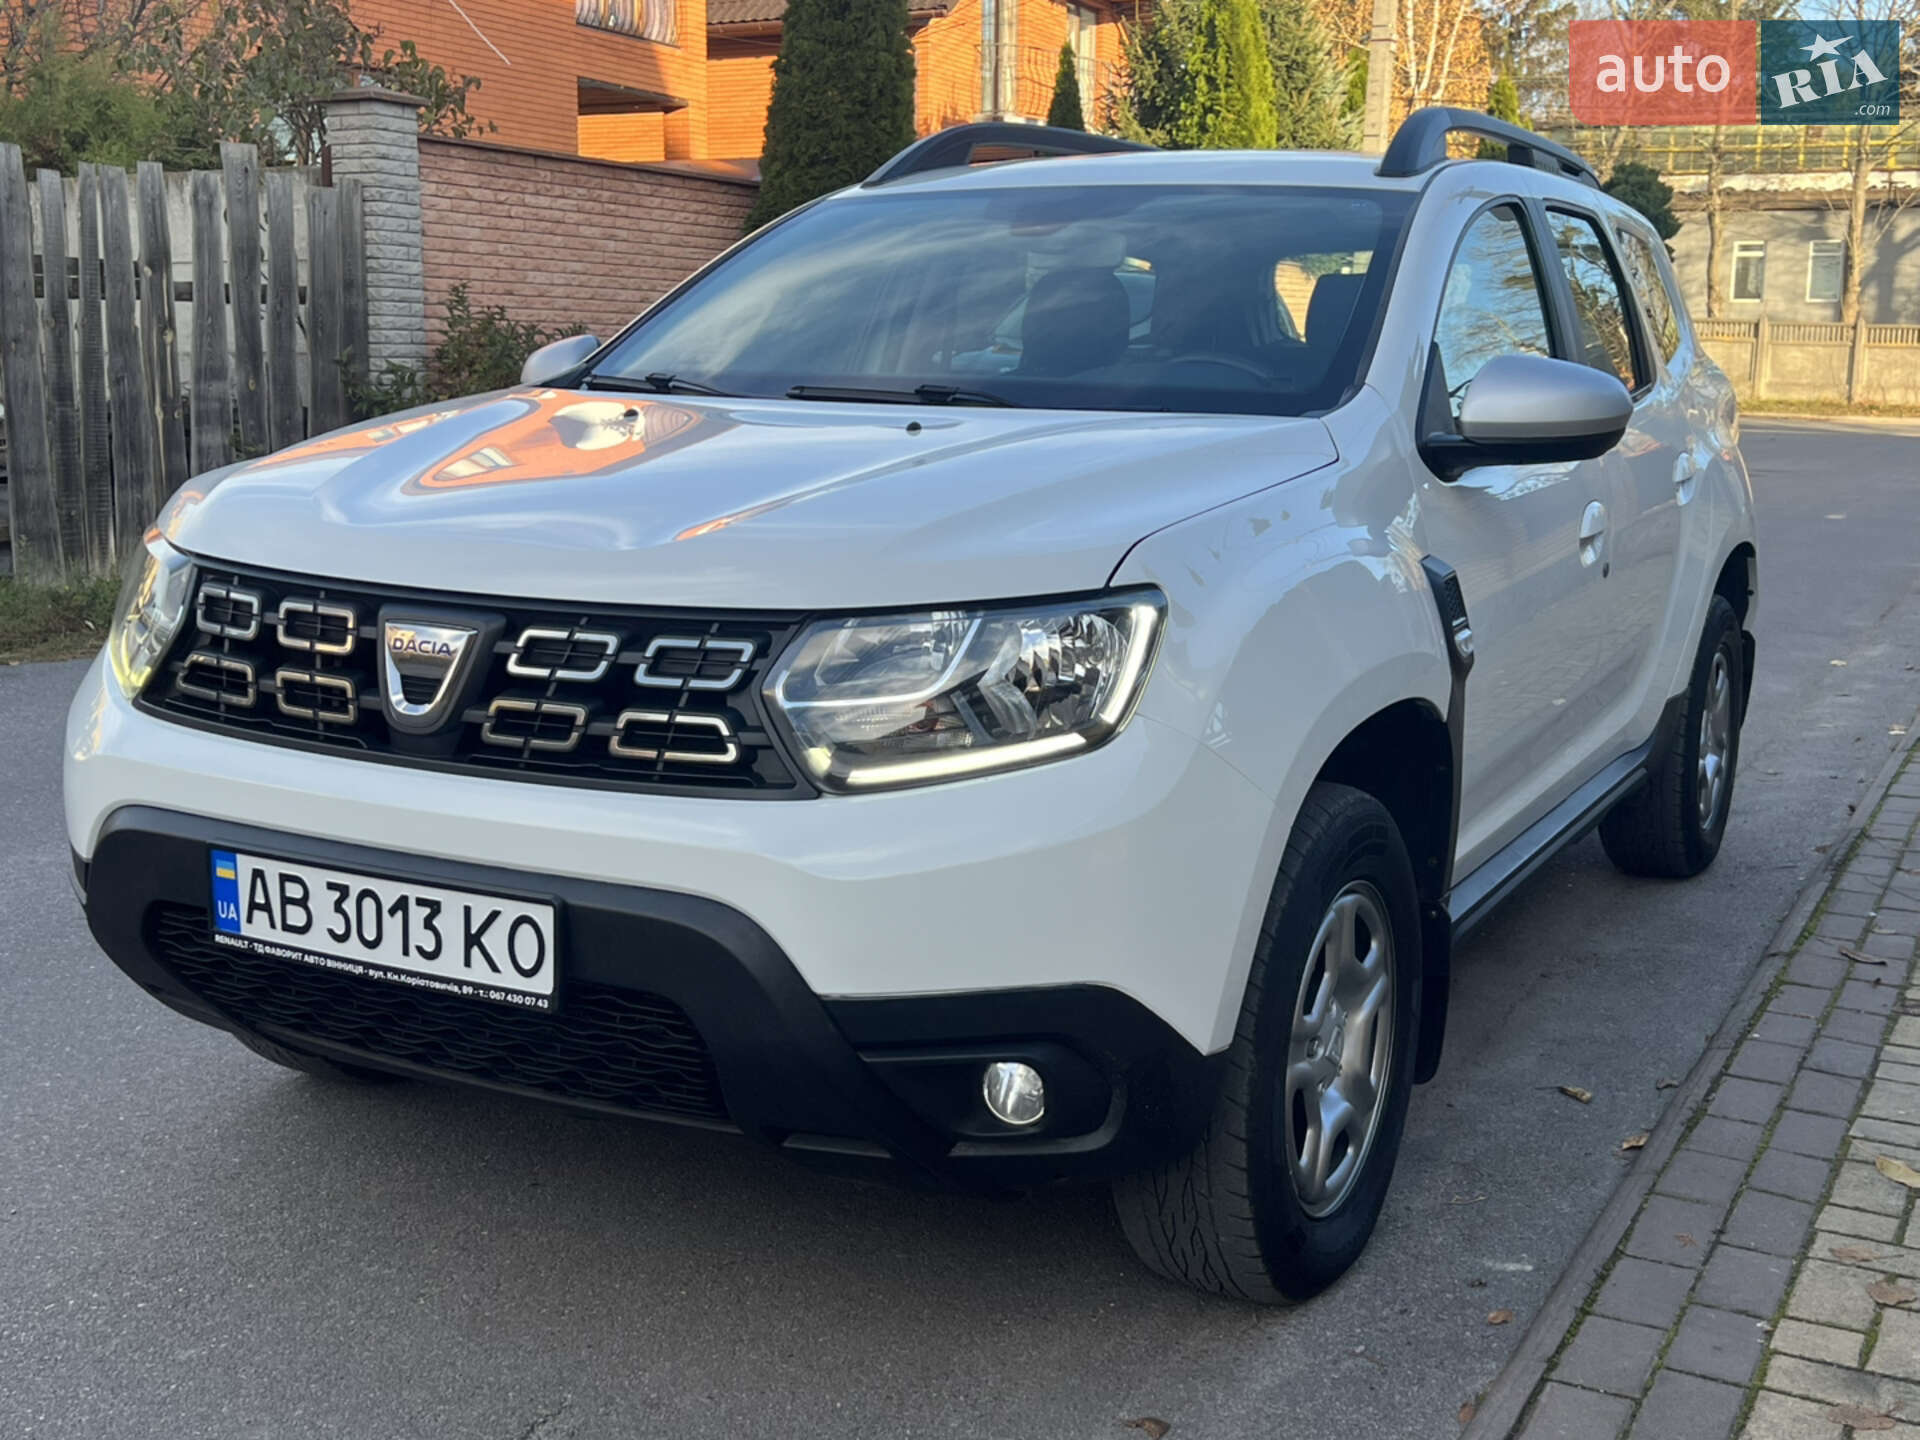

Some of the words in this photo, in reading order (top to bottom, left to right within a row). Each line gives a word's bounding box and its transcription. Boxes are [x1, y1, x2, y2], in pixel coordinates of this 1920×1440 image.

[391, 637, 452, 657] DACIA
[217, 900, 238, 921] UA
[245, 867, 313, 936] AB
[325, 880, 443, 961] 3013
[462, 904, 546, 979] KO
[214, 933, 249, 949] RENAULT
[303, 953, 326, 966] АВТО
[506, 993, 524, 1004] 430
[524, 996, 536, 1006] 07
[536, 999, 549, 1008] 43
